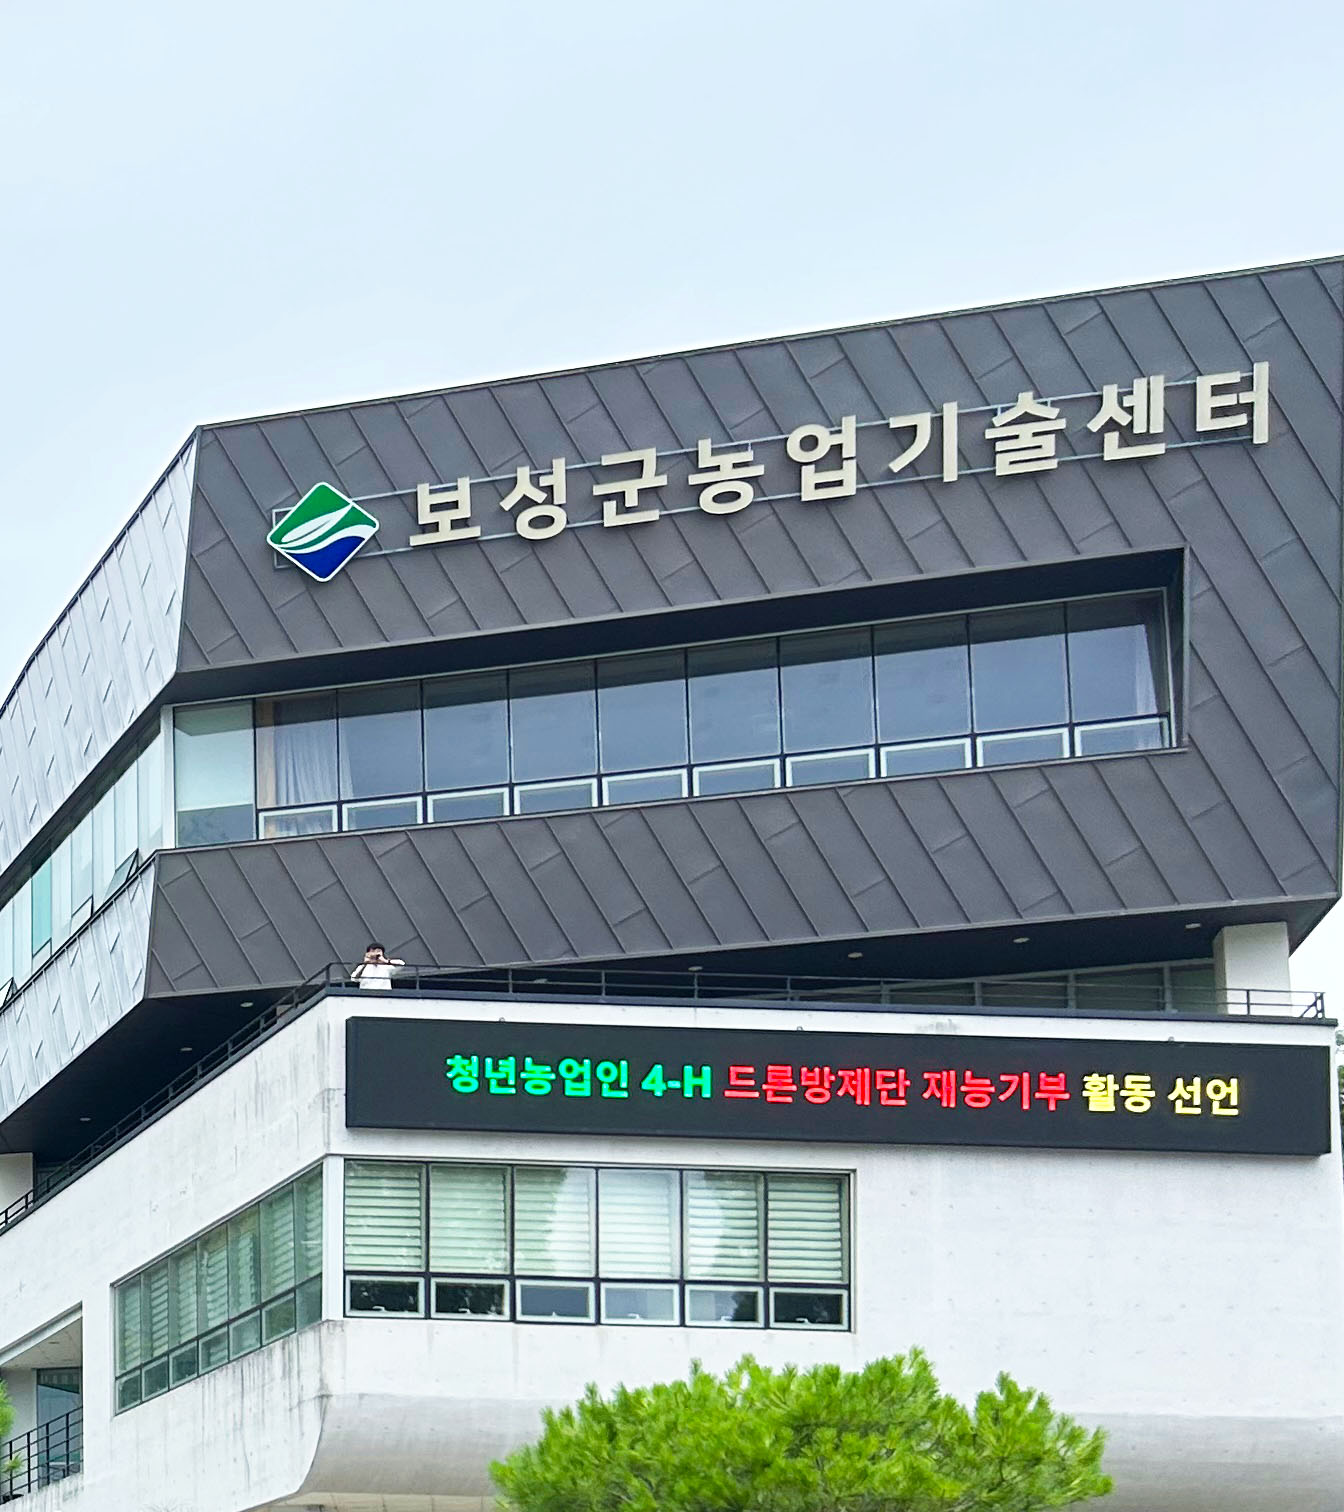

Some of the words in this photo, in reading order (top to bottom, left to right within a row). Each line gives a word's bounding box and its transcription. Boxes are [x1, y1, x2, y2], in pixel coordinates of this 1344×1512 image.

[408, 361, 1271, 548] 보성군농업기술센터
[445, 1053, 630, 1099] 청년농업인
[640, 1063, 713, 1099] 4-H
[723, 1064, 912, 1107] 드론방제단
[921, 1069, 1072, 1111] 재능기부
[1081, 1072, 1157, 1113] 활동
[1166, 1075, 1240, 1116] 선언
